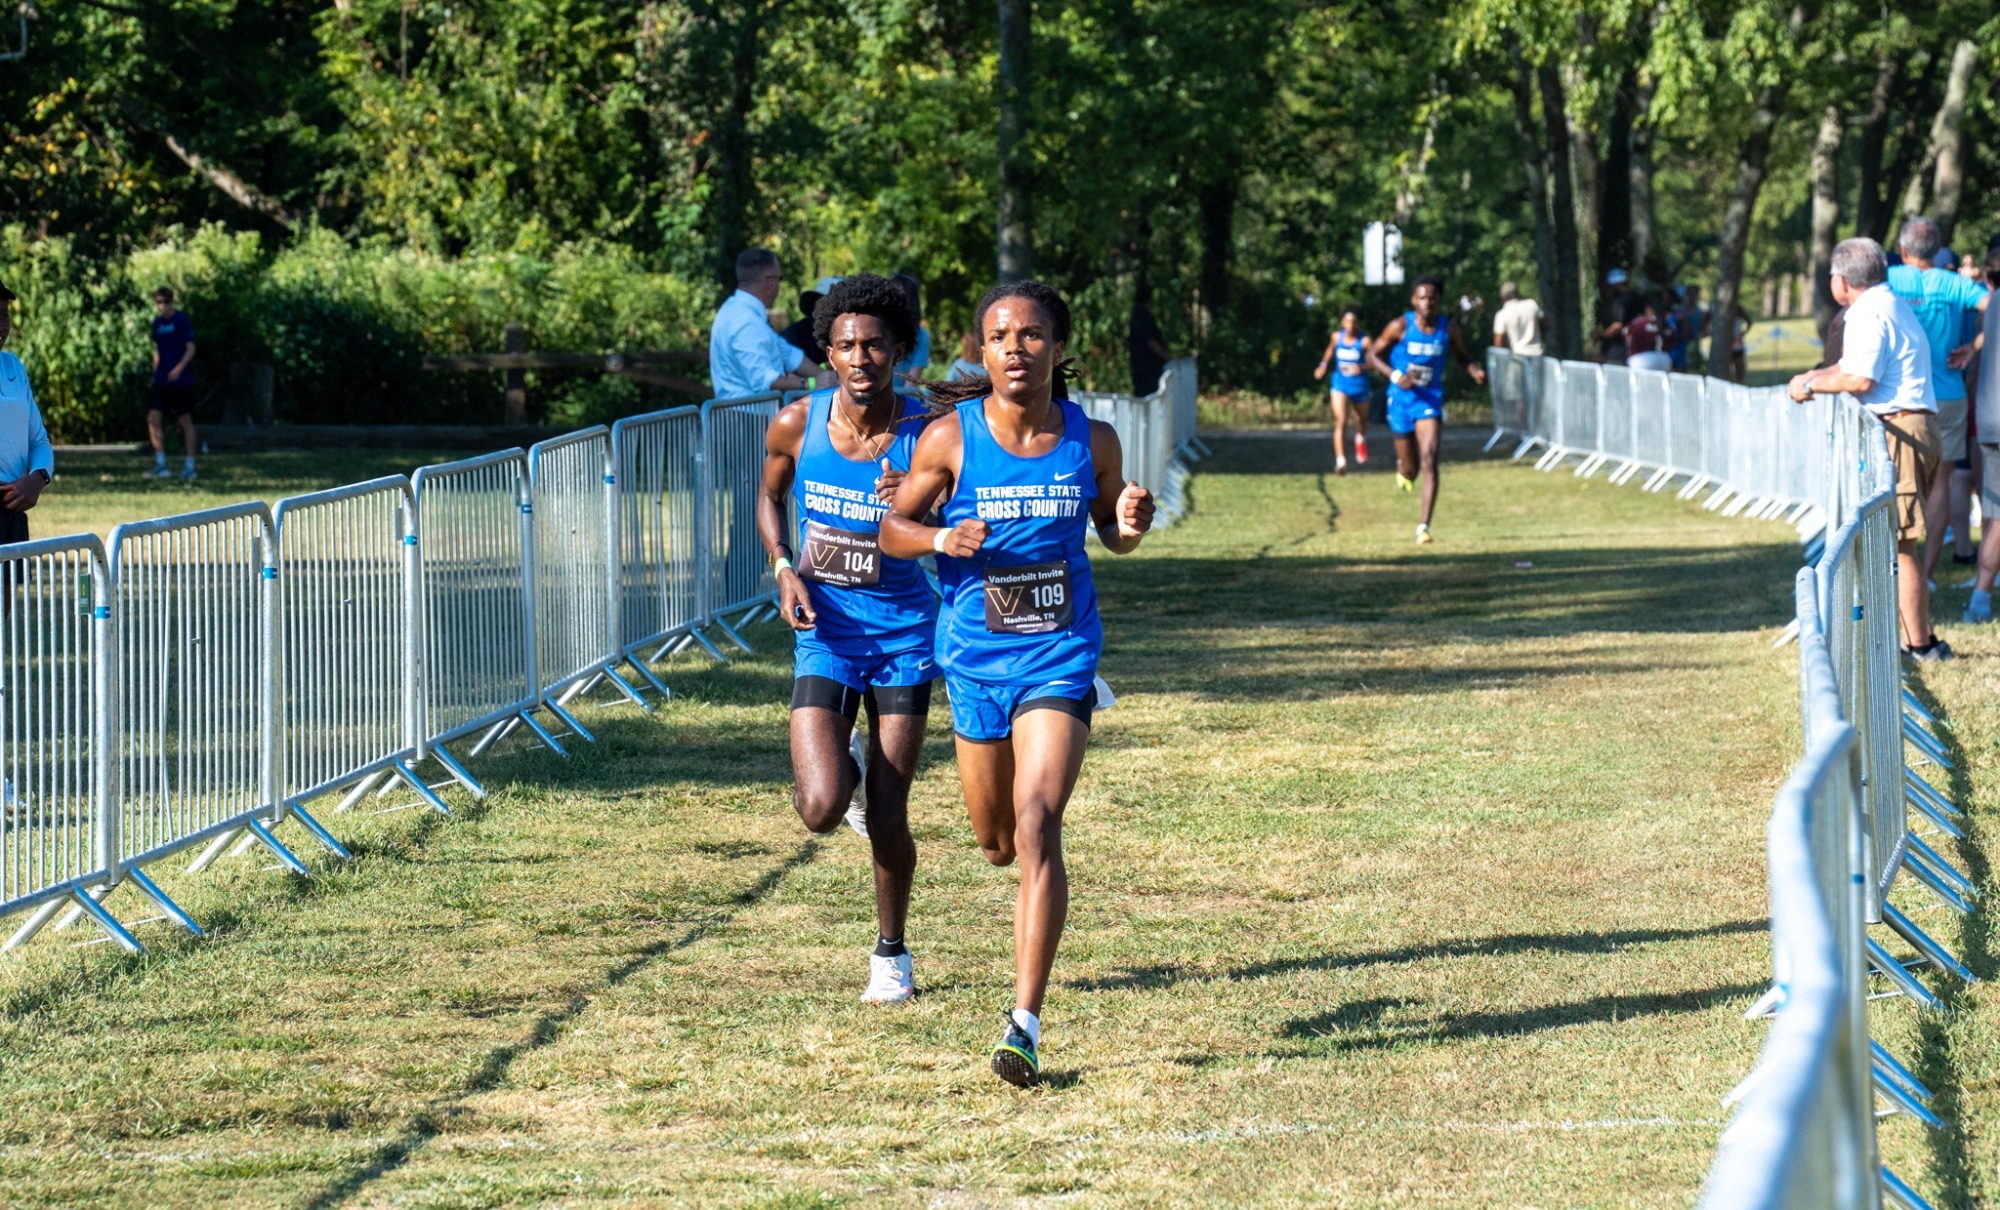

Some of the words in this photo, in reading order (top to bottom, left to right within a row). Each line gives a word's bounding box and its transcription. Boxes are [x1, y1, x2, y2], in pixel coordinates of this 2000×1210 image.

[804, 480, 865, 503] TENNESSEE
[975, 485, 1045, 499] TENNESSEE
[1048, 485, 1081, 497] STATE
[805, 493, 841, 516] CROSS
[977, 500, 1021, 519] CROSS
[1023, 499, 1080, 517] COUNTRY
[810, 529, 851, 545] Vanderbilt
[852, 538, 877, 548] Invite
[843, 551, 874, 574] 104
[814, 570, 849, 582] Nashville,
[988, 573, 1037, 584] Vanderbilt
[1038, 569, 1064, 579] Invite
[1031, 583, 1065, 608] 109
[1003, 614, 1042, 624] Nashville,
[1043, 612, 1055, 620] TN
